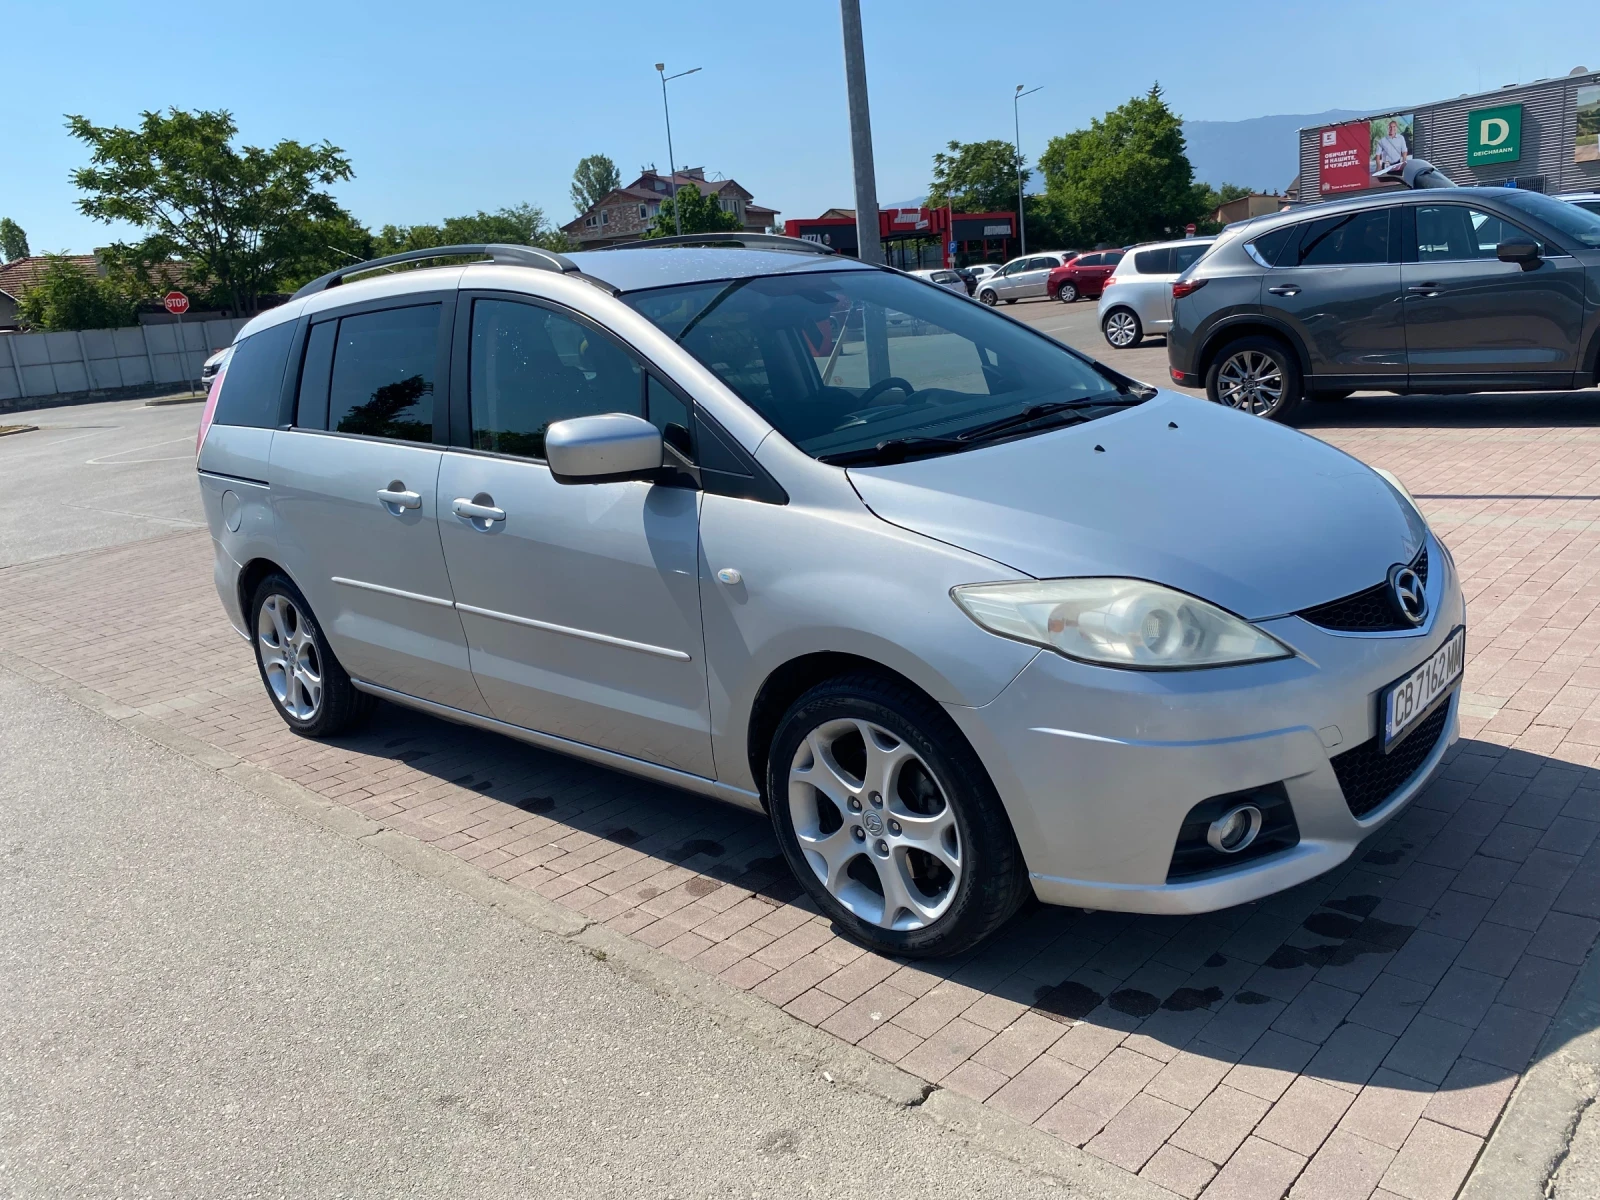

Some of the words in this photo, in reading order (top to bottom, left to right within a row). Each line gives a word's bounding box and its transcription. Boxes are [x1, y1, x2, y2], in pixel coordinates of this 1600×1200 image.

[1480, 118, 1510, 146] D
[1324, 150, 1347, 159] ОБИЧАТ
[1473, 147, 1513, 157] DEICHMANN
[166, 298, 187, 308] STOP
[1415, 651, 1446, 710] 7162
